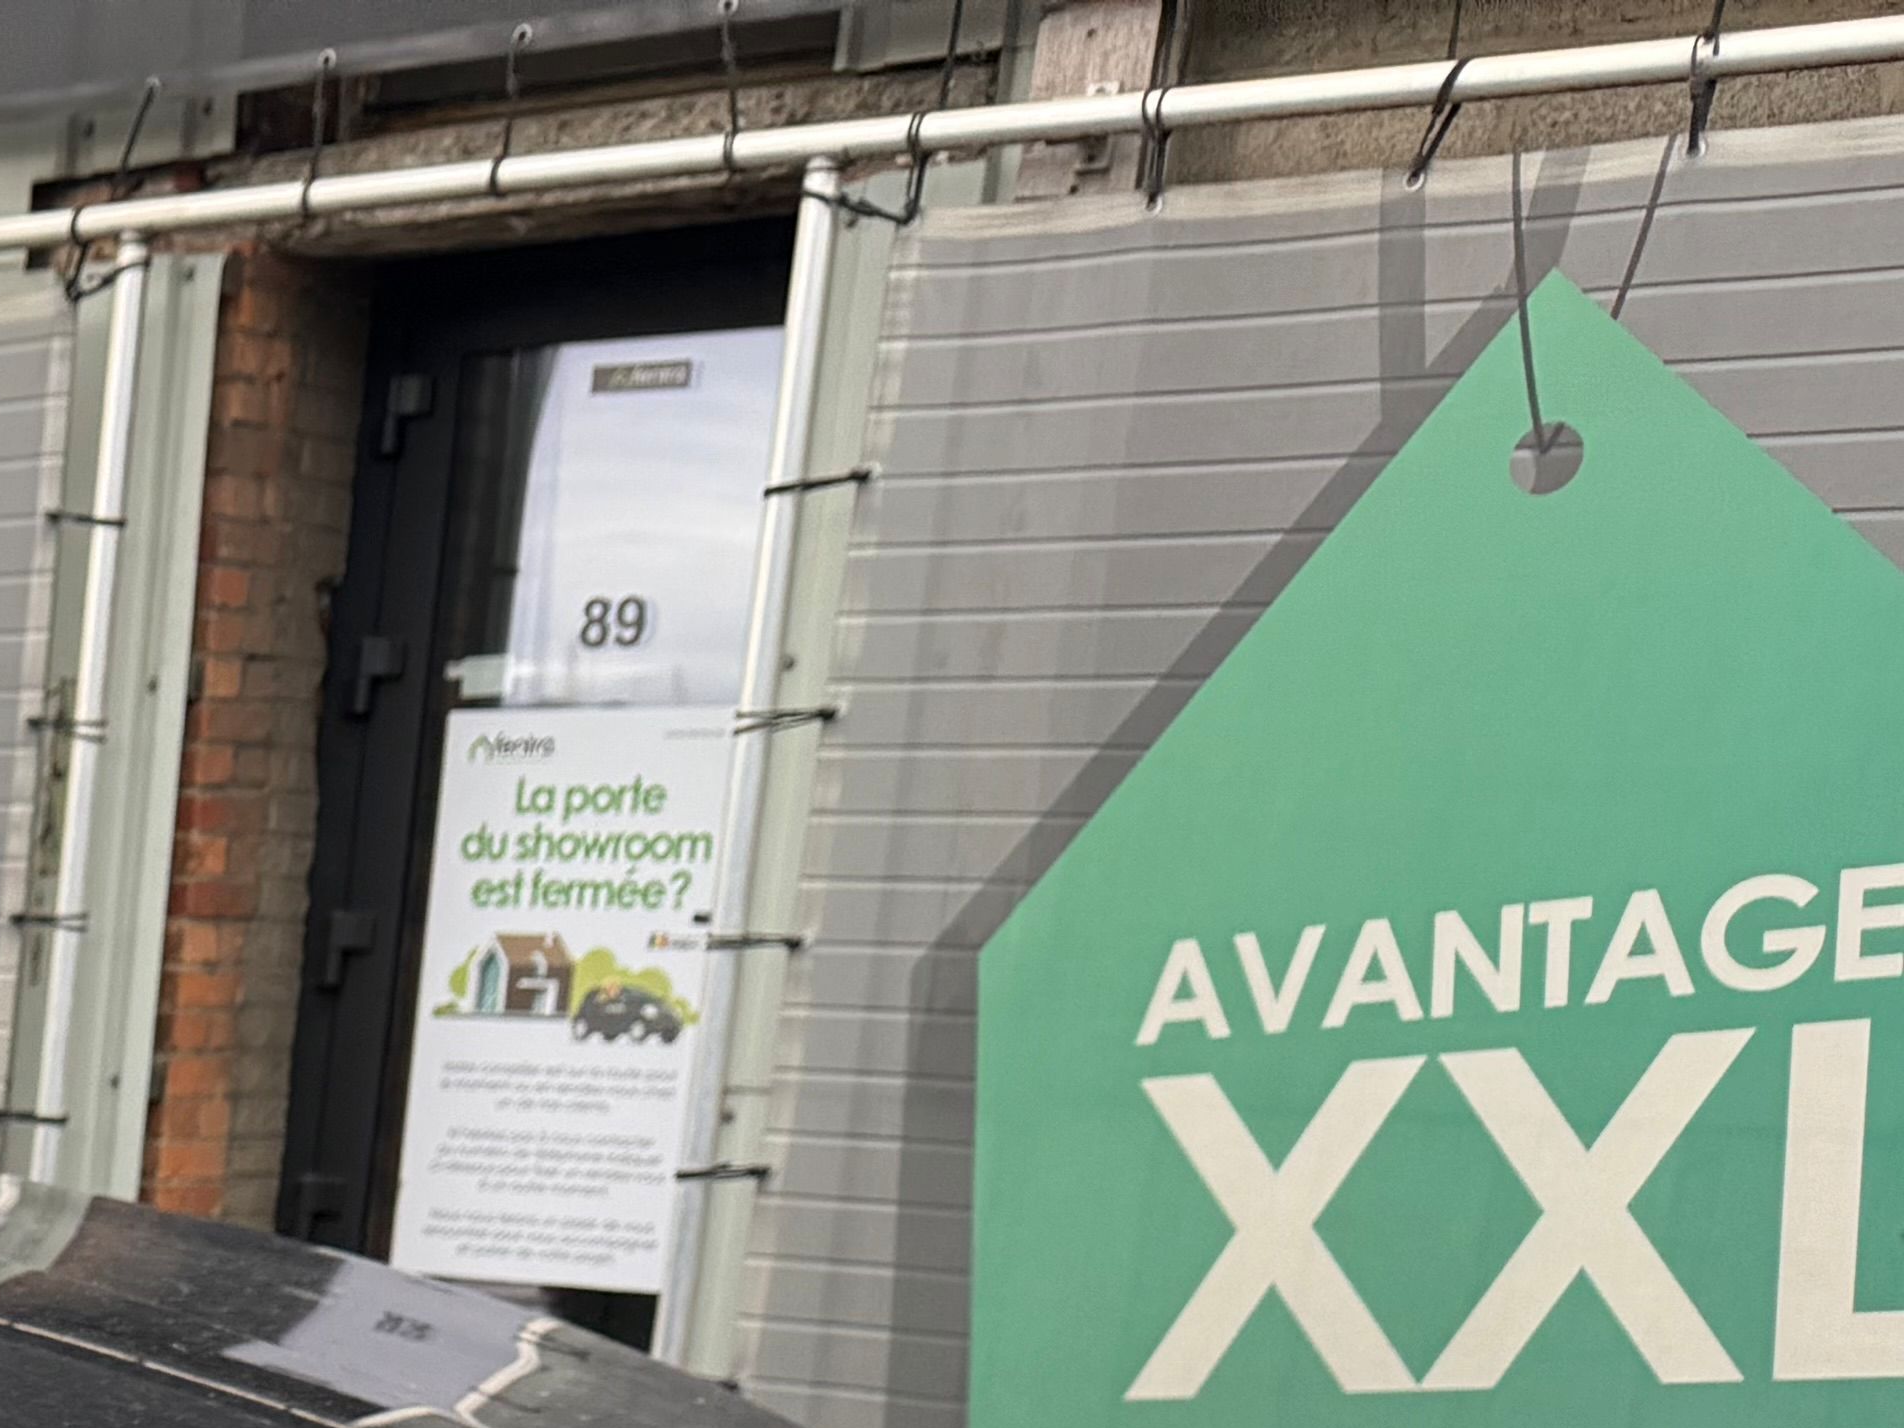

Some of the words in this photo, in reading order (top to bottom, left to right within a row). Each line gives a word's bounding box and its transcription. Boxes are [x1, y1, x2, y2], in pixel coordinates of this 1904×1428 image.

[580, 596, 646, 648] 89
[515, 776, 555, 815] La
[562, 774, 668, 822] porte
[460, 823, 508, 862] du
[515, 823, 714, 864] showroom
[470, 868, 523, 909] est
[1133, 862, 1904, 1046] AVANTAGE
[1122, 1018, 1904, 1400] XXL
